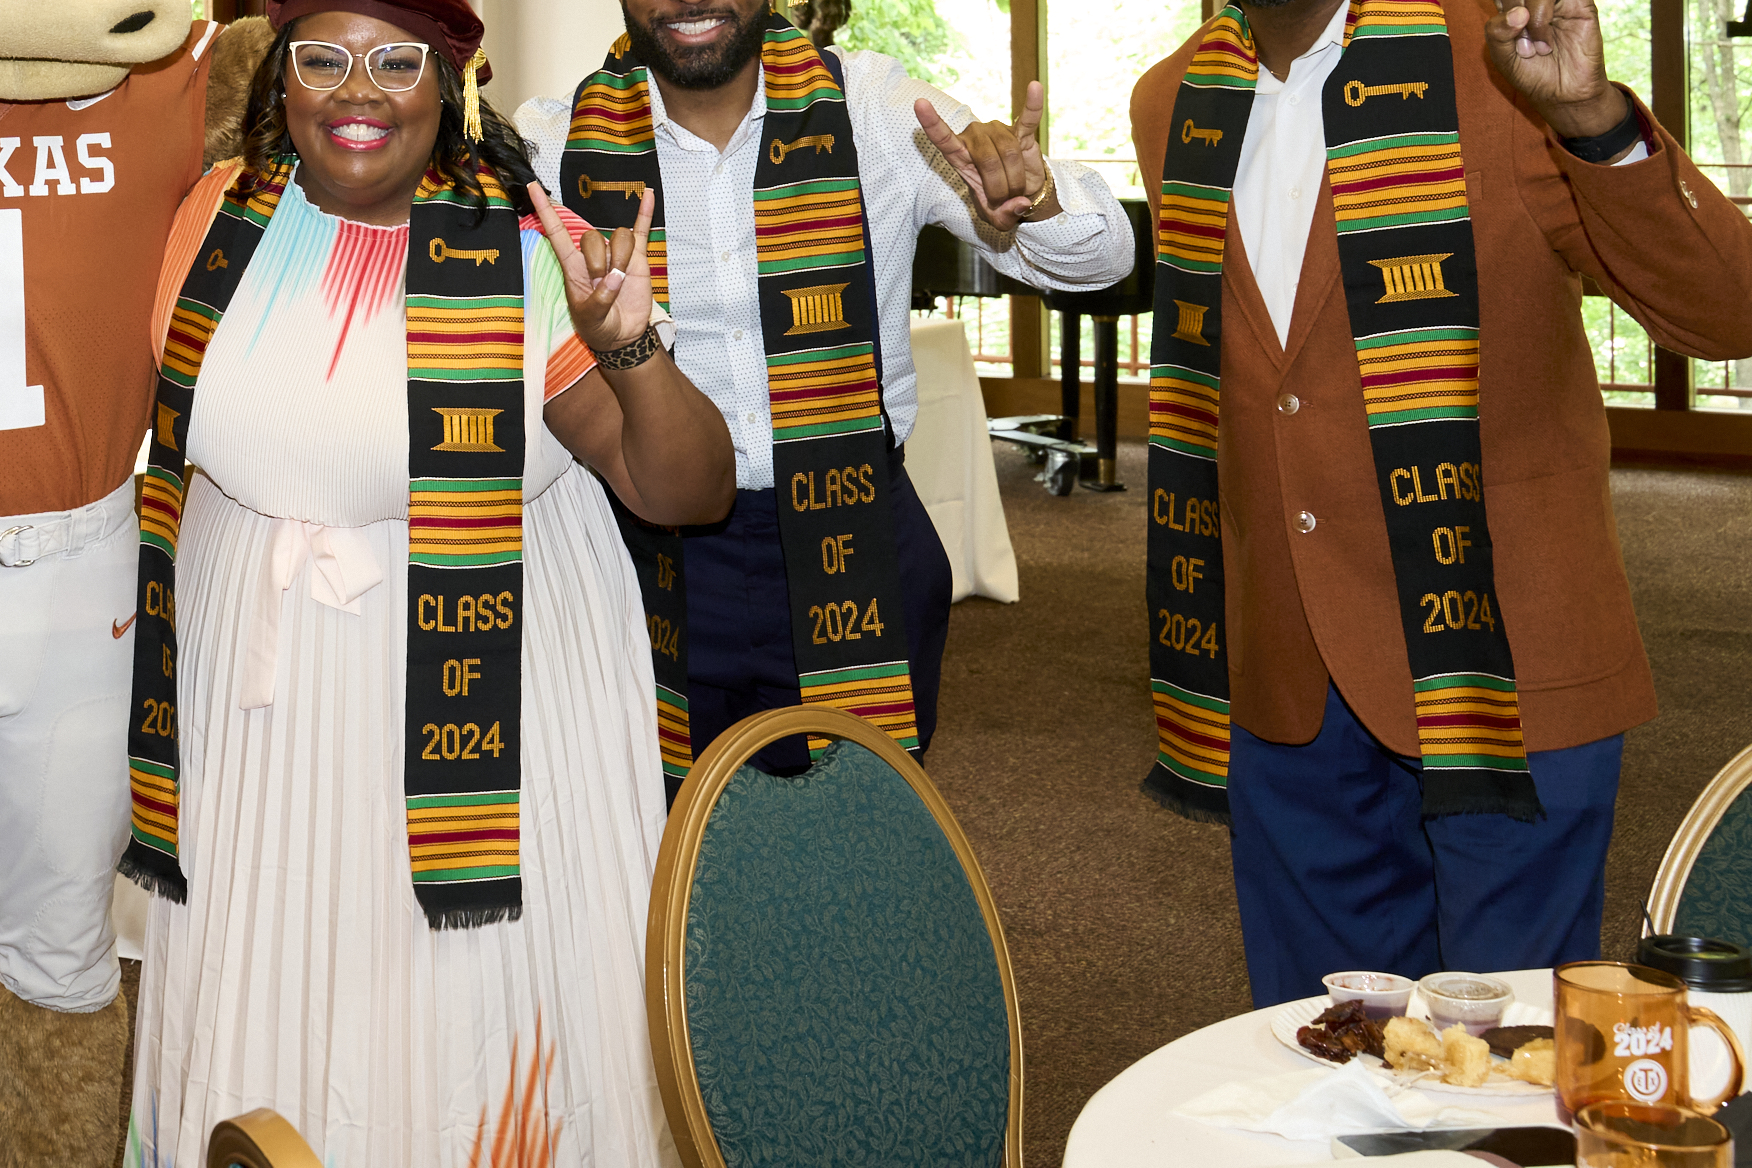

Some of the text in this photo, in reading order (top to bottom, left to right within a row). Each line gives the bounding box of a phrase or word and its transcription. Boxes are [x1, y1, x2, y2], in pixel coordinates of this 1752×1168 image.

[791, 463, 876, 513] CLASS
[1389, 461, 1480, 507] CLASS
[1153, 487, 1219, 538] CLASS
[821, 533, 855, 575] OF
[1432, 525, 1473, 565] OF
[657, 552, 677, 592] OF
[1171, 555, 1205, 594] OF
[418, 590, 514, 633] CLASS
[808, 597, 885, 645] 2024
[1419, 590, 1496, 634] 2024
[646, 610, 681, 662] 024
[1158, 609, 1219, 659] 2024
[441, 657, 482, 698] OF
[421, 721, 506, 761] 2024
[1613, 1026, 1673, 1057] 2024
